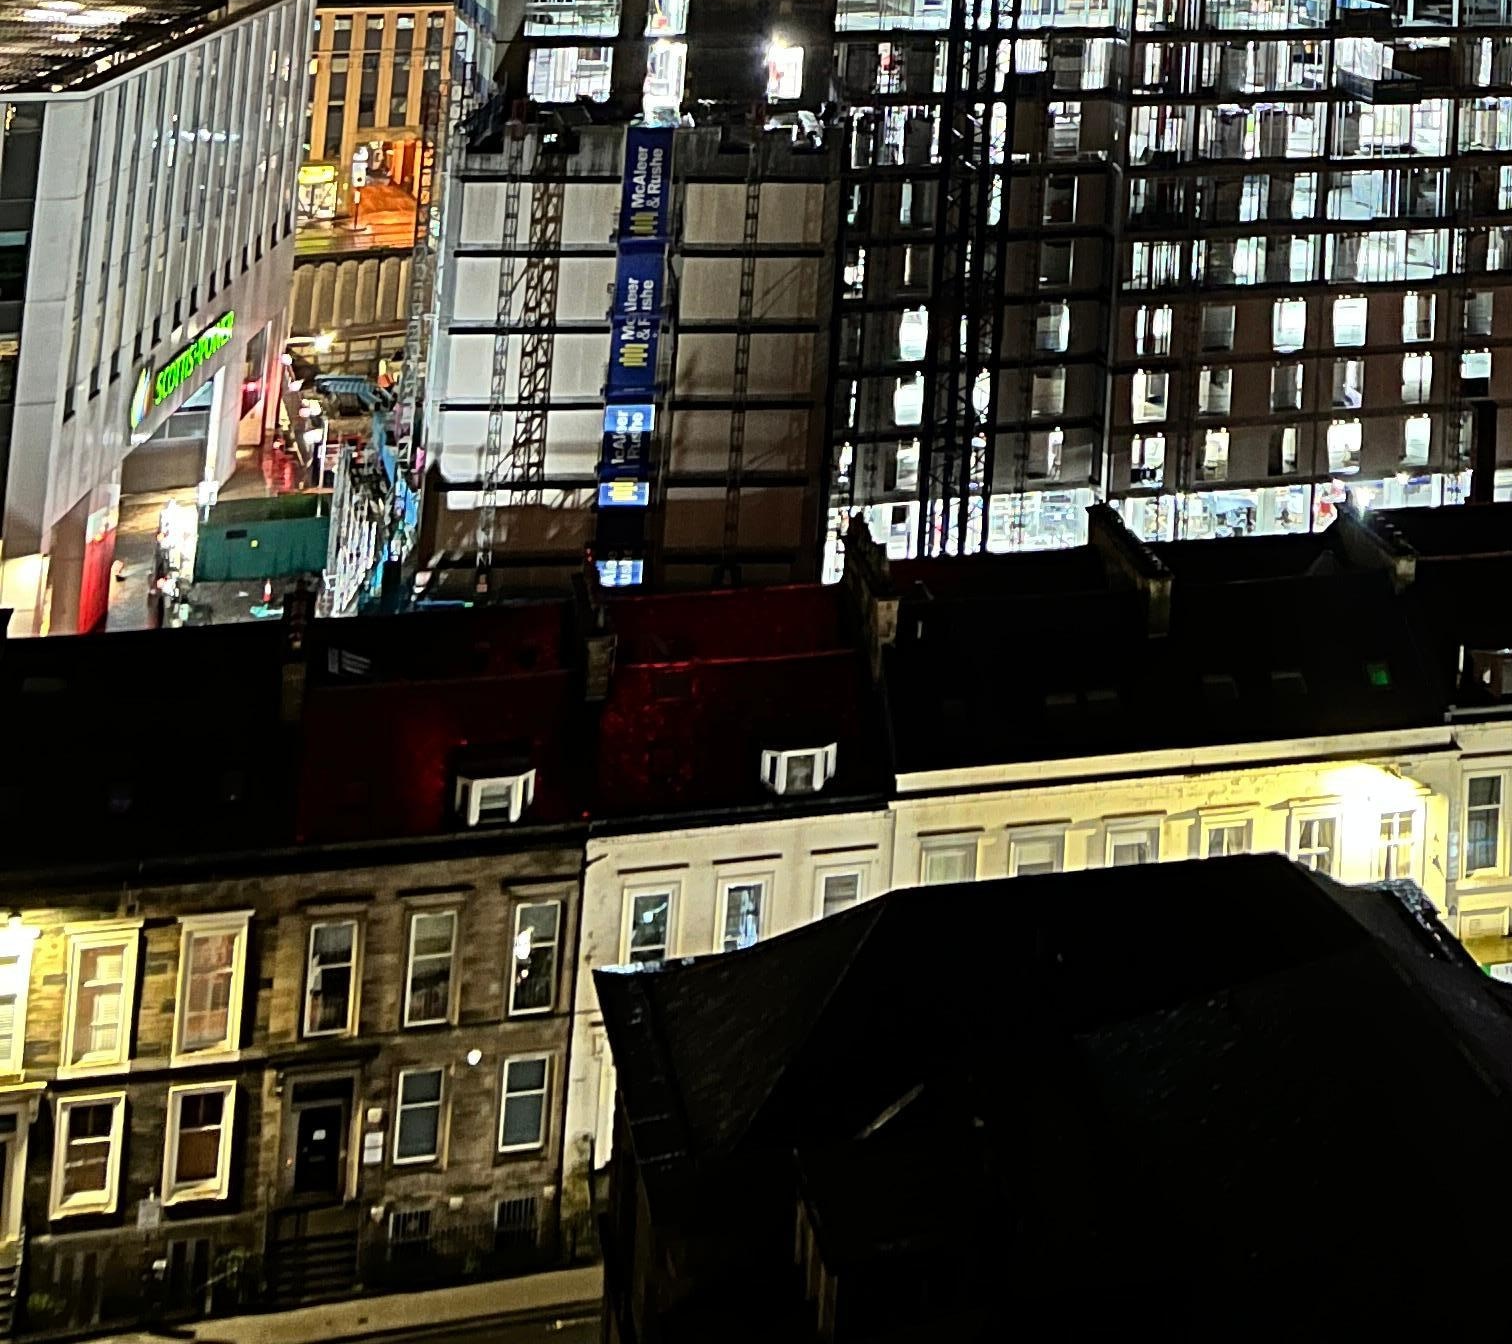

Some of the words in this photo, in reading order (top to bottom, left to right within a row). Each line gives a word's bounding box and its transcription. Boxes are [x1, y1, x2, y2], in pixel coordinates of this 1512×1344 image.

[631, 145, 649, 209] McAleer
[647, 148, 664, 194] Rushe
[646, 196, 660, 209] &
[636, 328, 651, 341] &
